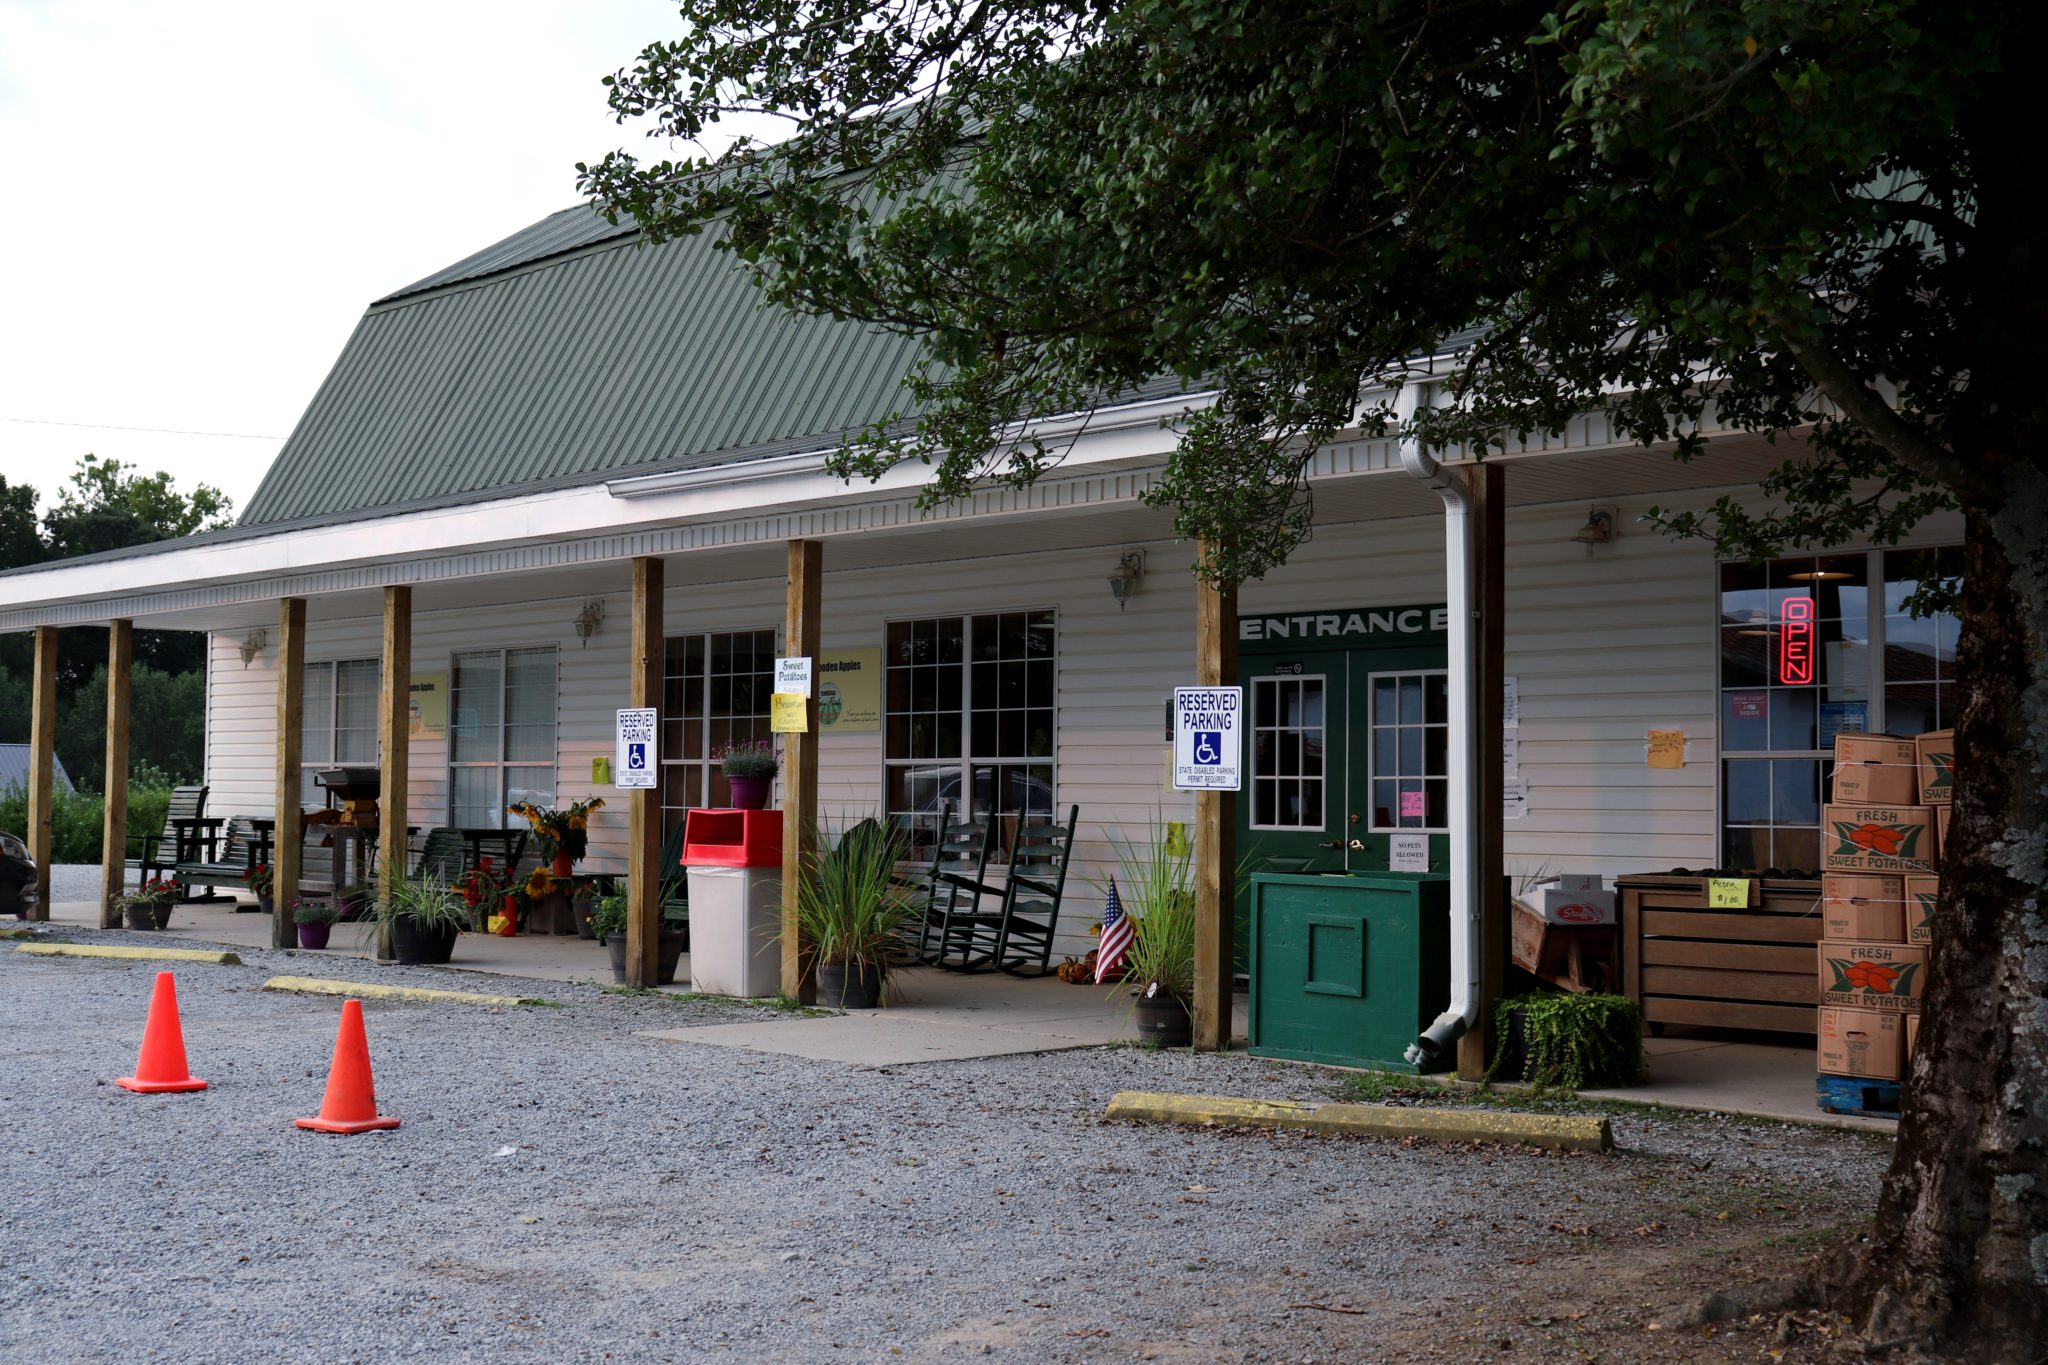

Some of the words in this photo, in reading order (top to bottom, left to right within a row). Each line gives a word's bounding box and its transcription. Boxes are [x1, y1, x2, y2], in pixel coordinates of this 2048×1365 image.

[1239, 608, 1448, 640] ENTRANCE
[1787, 603, 1808, 679] OPEN
[782, 660, 804, 670] Sweet
[838, 660, 861, 672] Apples
[778, 671, 808, 682] Potatoes
[1179, 694, 1237, 711] RESERVED
[620, 714, 653, 728] RESERVED
[1184, 713, 1232, 730] PARKING
[623, 729, 651, 742] PARKING
[1925, 789, 1950, 799] SWE
[1857, 810, 1898, 822] FRESH
[1828, 856, 1864, 867] SWEET
[1868, 857, 1930, 870] POTATOES
[1851, 948, 1892, 960] FRESH
[1825, 992, 1861, 1004] SWEET
[1864, 995, 1922, 1009] POTATOES
